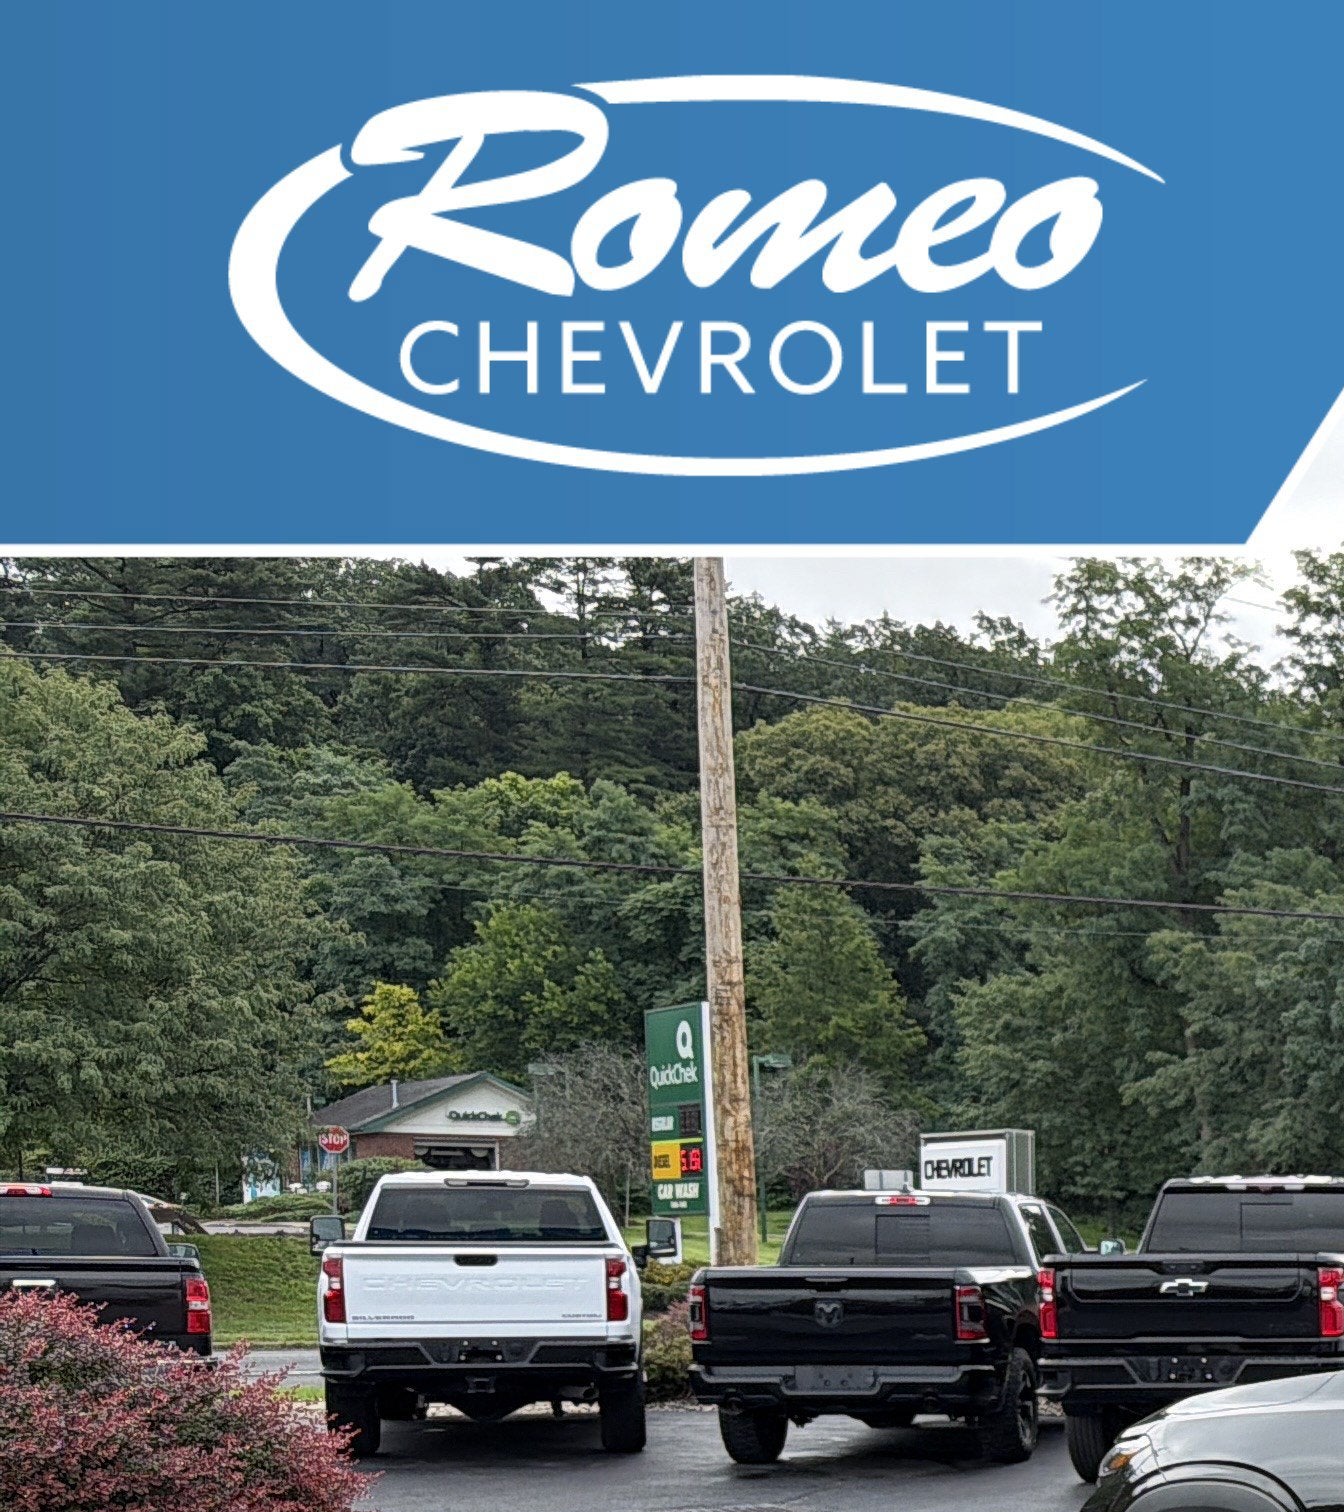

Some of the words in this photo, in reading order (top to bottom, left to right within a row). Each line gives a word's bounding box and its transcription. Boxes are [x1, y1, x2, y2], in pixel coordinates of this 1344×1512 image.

[650, 1061, 698, 1089] QuickChek
[321, 1133, 348, 1145] STOP
[924, 1156, 993, 1180] CHEVROLET
